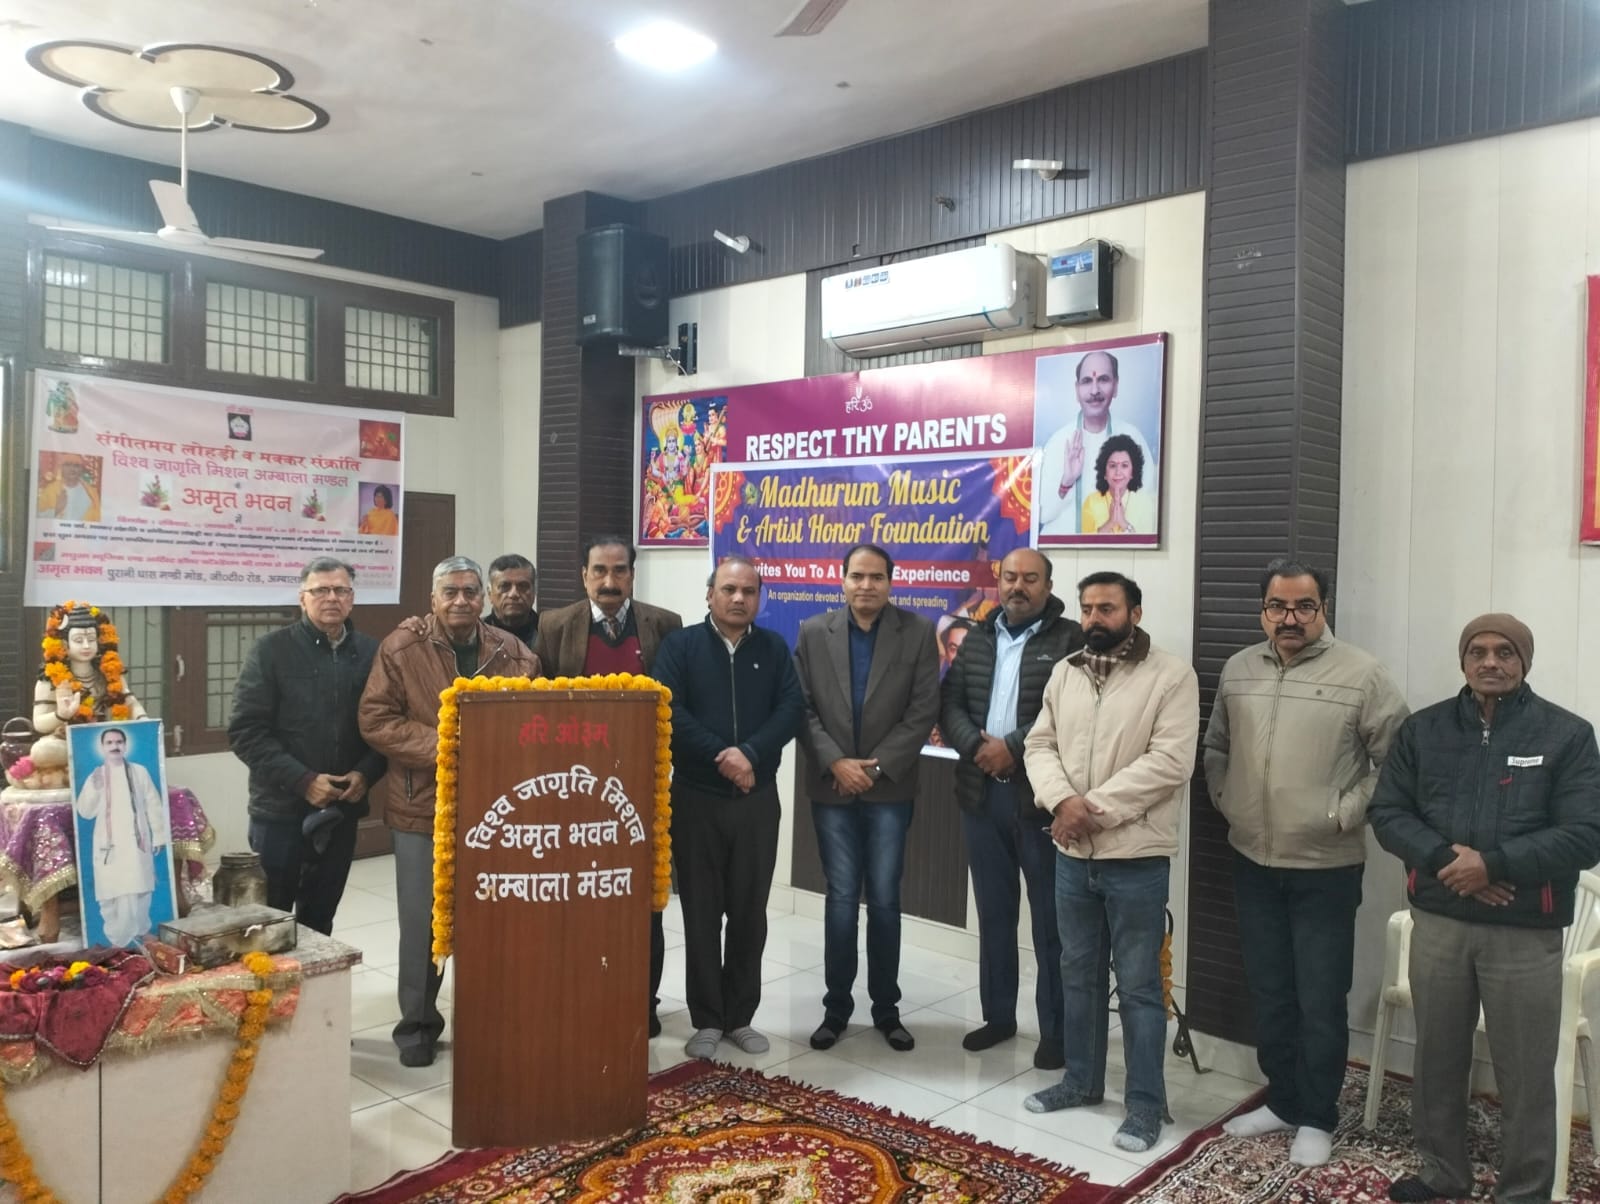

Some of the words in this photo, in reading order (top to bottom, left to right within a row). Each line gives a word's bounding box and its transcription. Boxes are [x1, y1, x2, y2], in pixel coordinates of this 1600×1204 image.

[96, 431, 176, 454] संगीतमय
[746, 429, 836, 461] RESPECT
[842, 424, 888, 455] THY
[894, 413, 1007, 451] PARENTS
[112, 450, 149, 470] विश्व
[154, 457, 201, 477] जागृति
[206, 460, 248, 480] मिशन
[253, 469, 307, 485] अम्बाला
[182, 487, 238, 513] अमृत
[245, 492, 292, 512] भवन
[759, 475, 881, 508] Madhurum
[888, 469, 961, 505] Music
[737, 514, 752, 543] &
[755, 513, 803, 546] Artist
[808, 513, 865, 544] Honor
[870, 512, 990, 544] Foundation
[38, 564, 69, 577] अमृत
[754, 562, 781, 577] vites
[785, 563, 806, 578] You
[809, 564, 824, 578] To
[827, 565, 836, 578] A
[892, 566, 970, 584] Experience
[768, 589, 776, 600] An
[778, 590, 814, 603] organization
[815, 591, 837, 603] devoted
[898, 595, 911, 606] and
[912, 597, 948, 611] spreading
[465, 795, 516, 849] विश्व
[513, 764, 599, 799] जागृति
[600, 776, 646, 845] मिशन
[500, 823, 561, 859] अमृत
[568, 819, 619, 848] भवन
[474, 872, 570, 902] अम्बाला
[577, 861, 633, 898] मंडल
